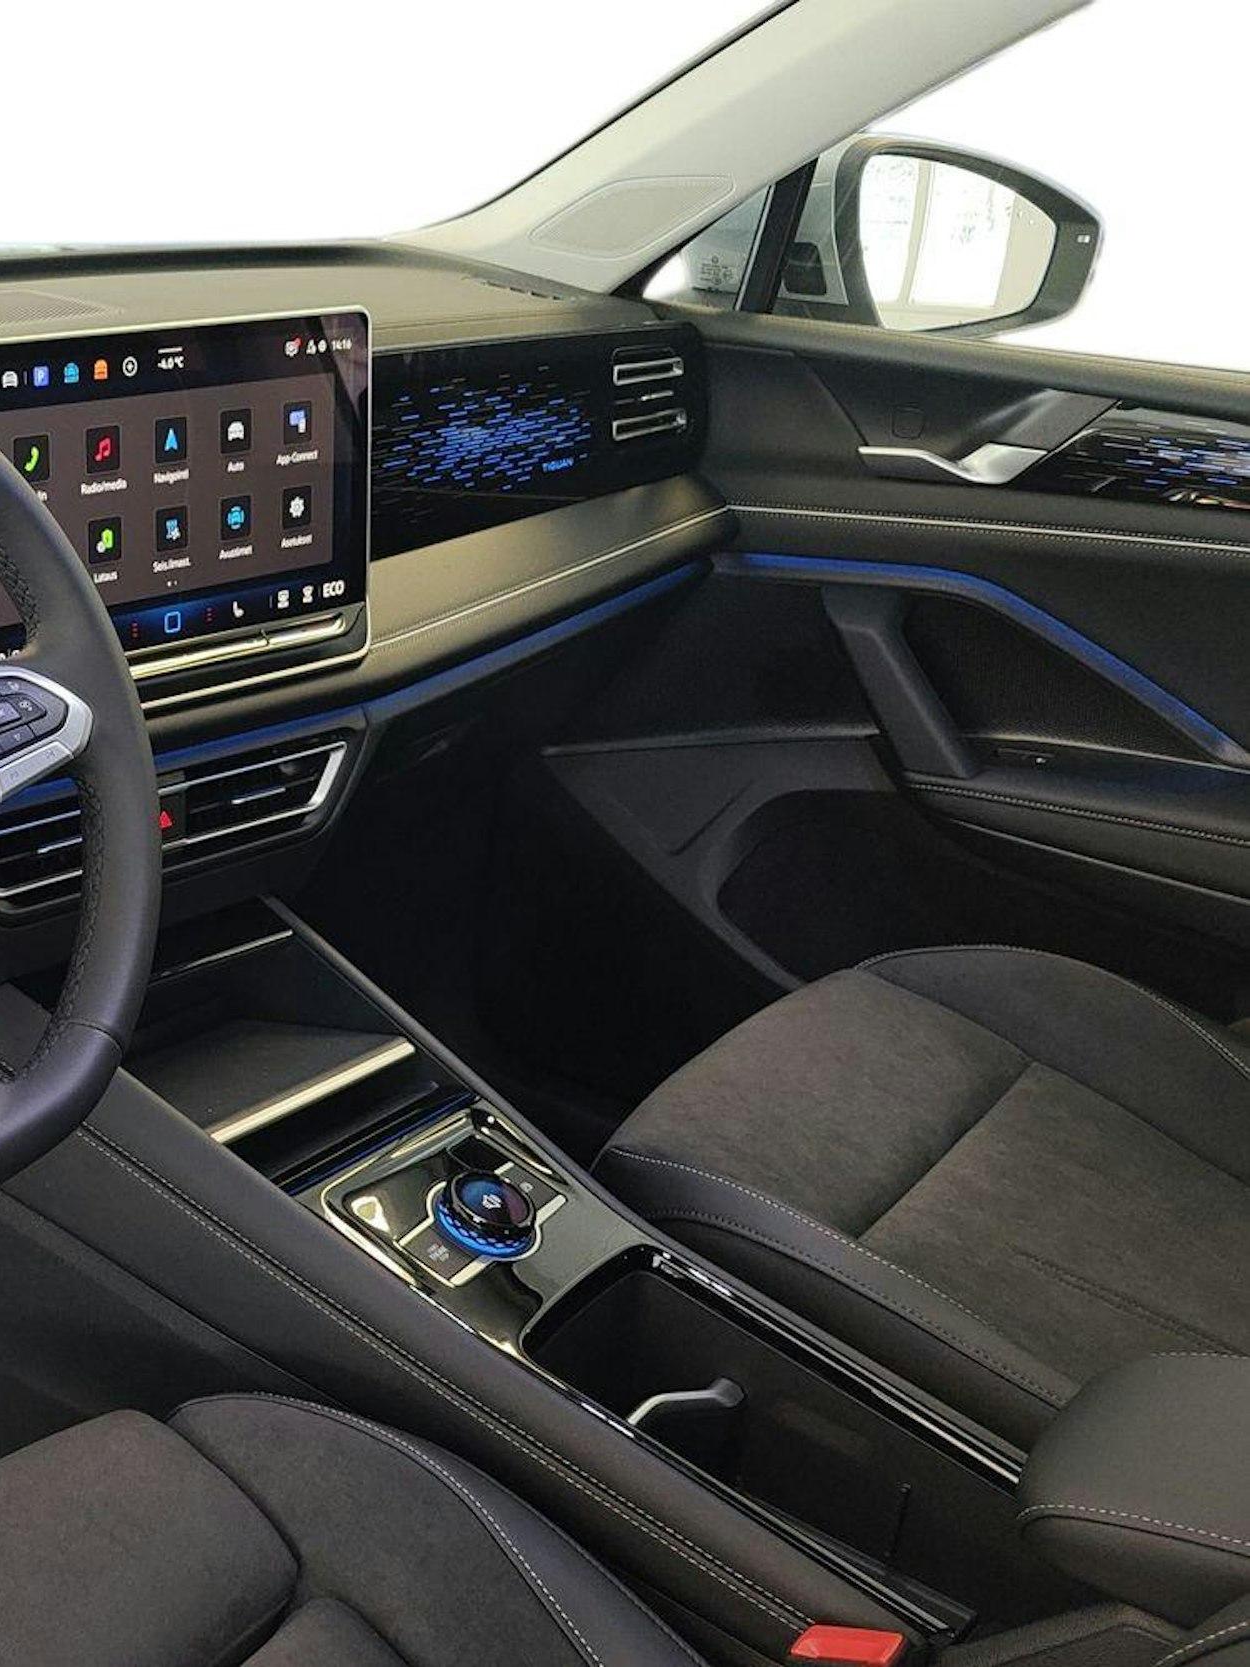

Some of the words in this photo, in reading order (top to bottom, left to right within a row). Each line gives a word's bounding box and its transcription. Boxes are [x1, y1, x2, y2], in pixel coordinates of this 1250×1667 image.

[276, 450, 319, 466] App-Connect
[542, 457, 574, 472] TIGUAN
[227, 461, 245, 473] Auto
[153, 469, 190, 485] Navigointi
[80, 478, 128, 495] Radio/media
[280, 533, 313, 549] Asetukset
[219, 545, 253, 560] Avustimet
[93, 571, 119, 585] Lataus
[322, 579, 346, 599] ECO
